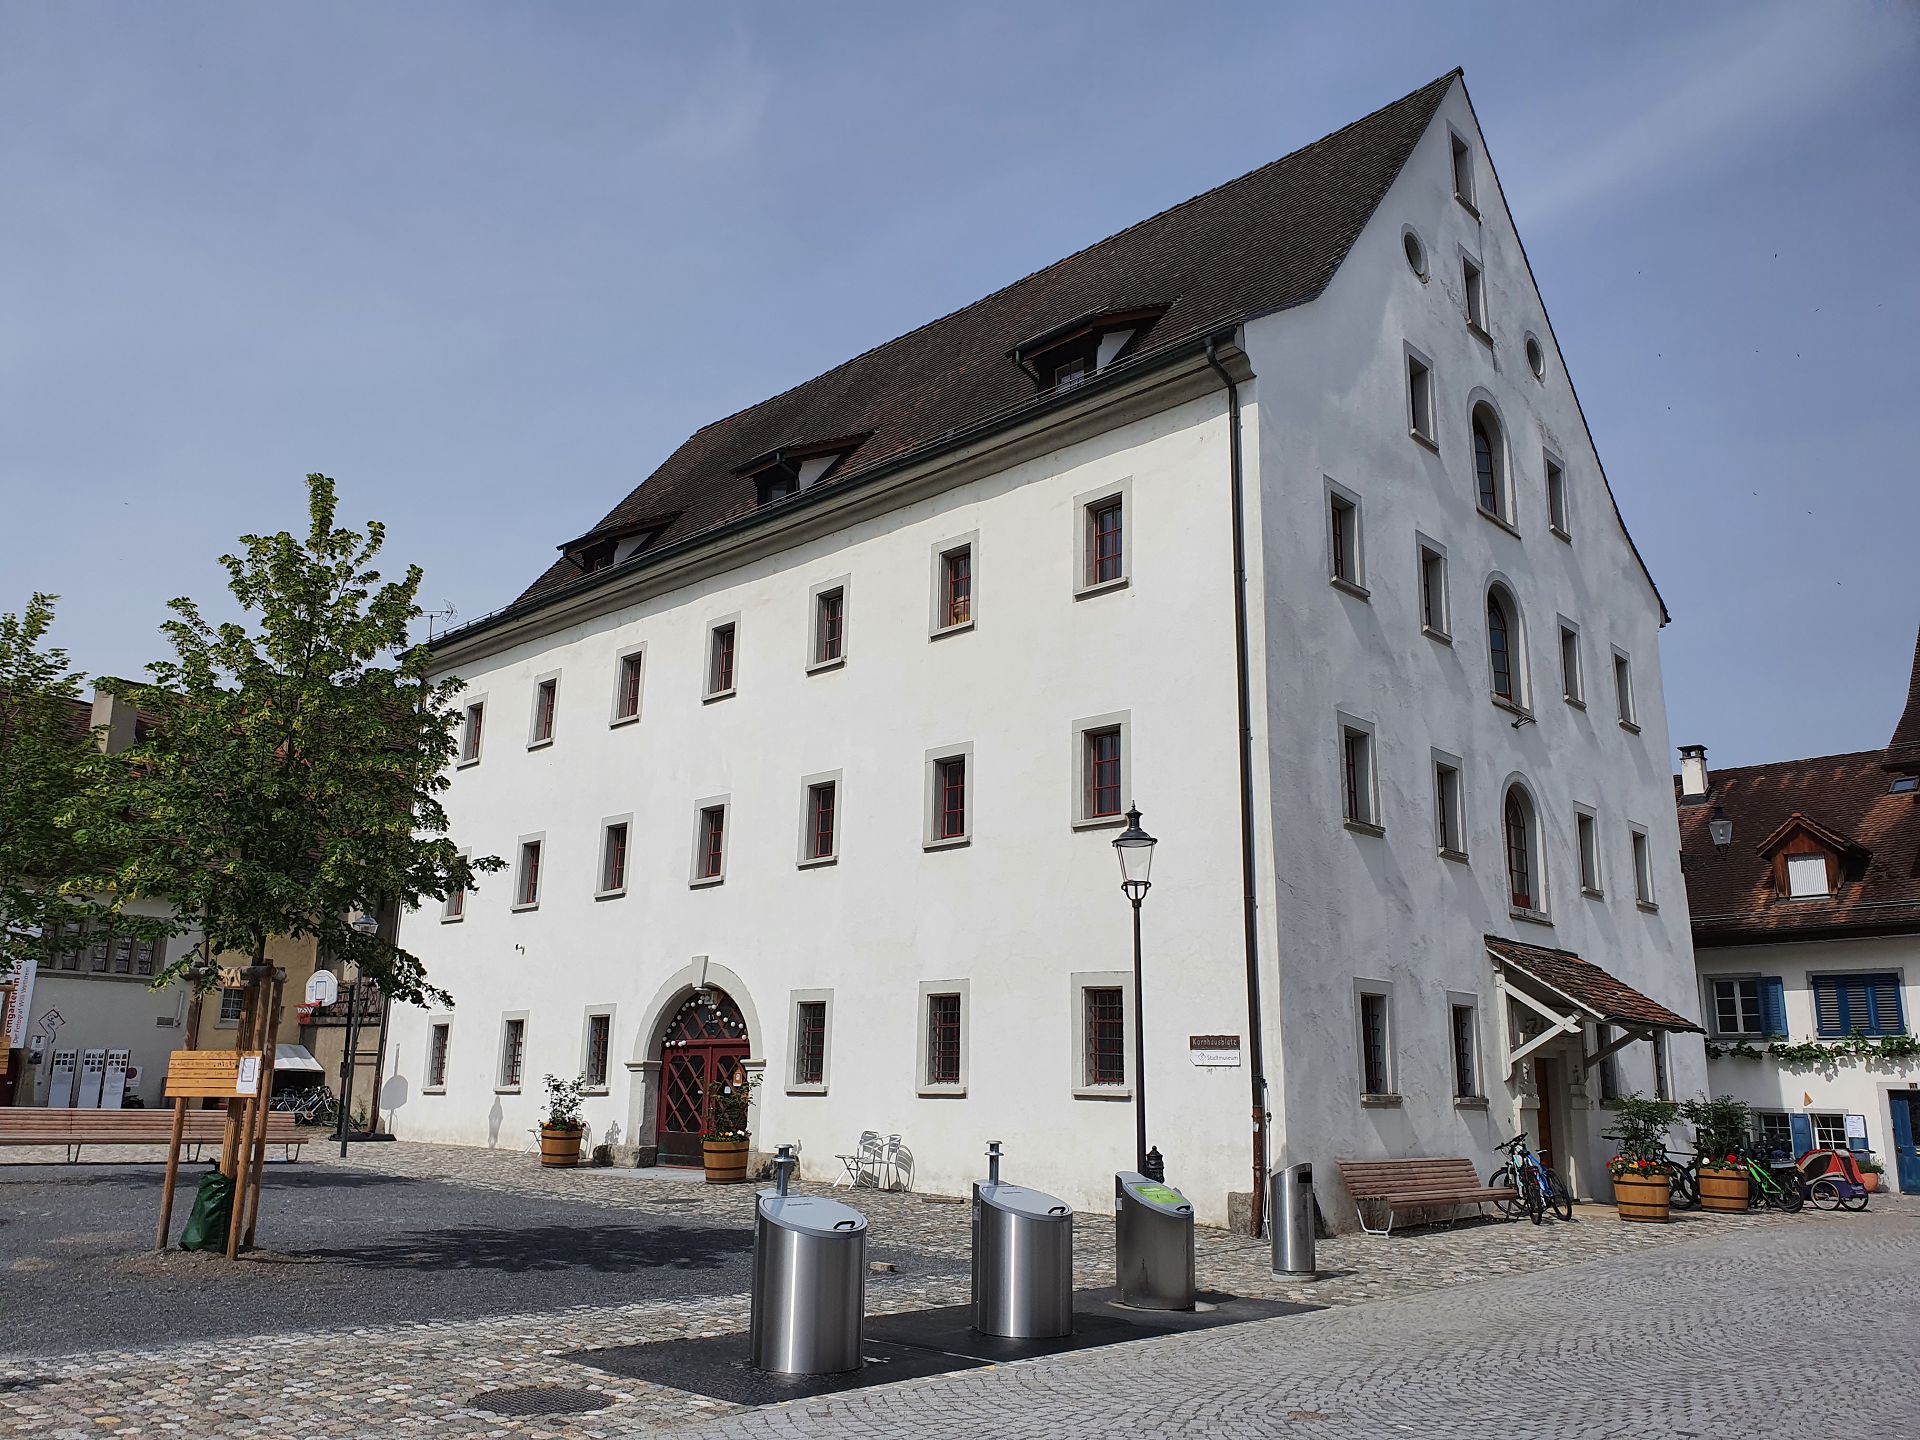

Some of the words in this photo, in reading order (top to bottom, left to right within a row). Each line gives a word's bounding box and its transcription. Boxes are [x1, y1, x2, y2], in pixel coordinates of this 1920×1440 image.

[5, 989, 17, 1037] remgarten
[14, 960, 22, 975] Fot
[1192, 1038, 1237, 1046] Kornhausplatz
